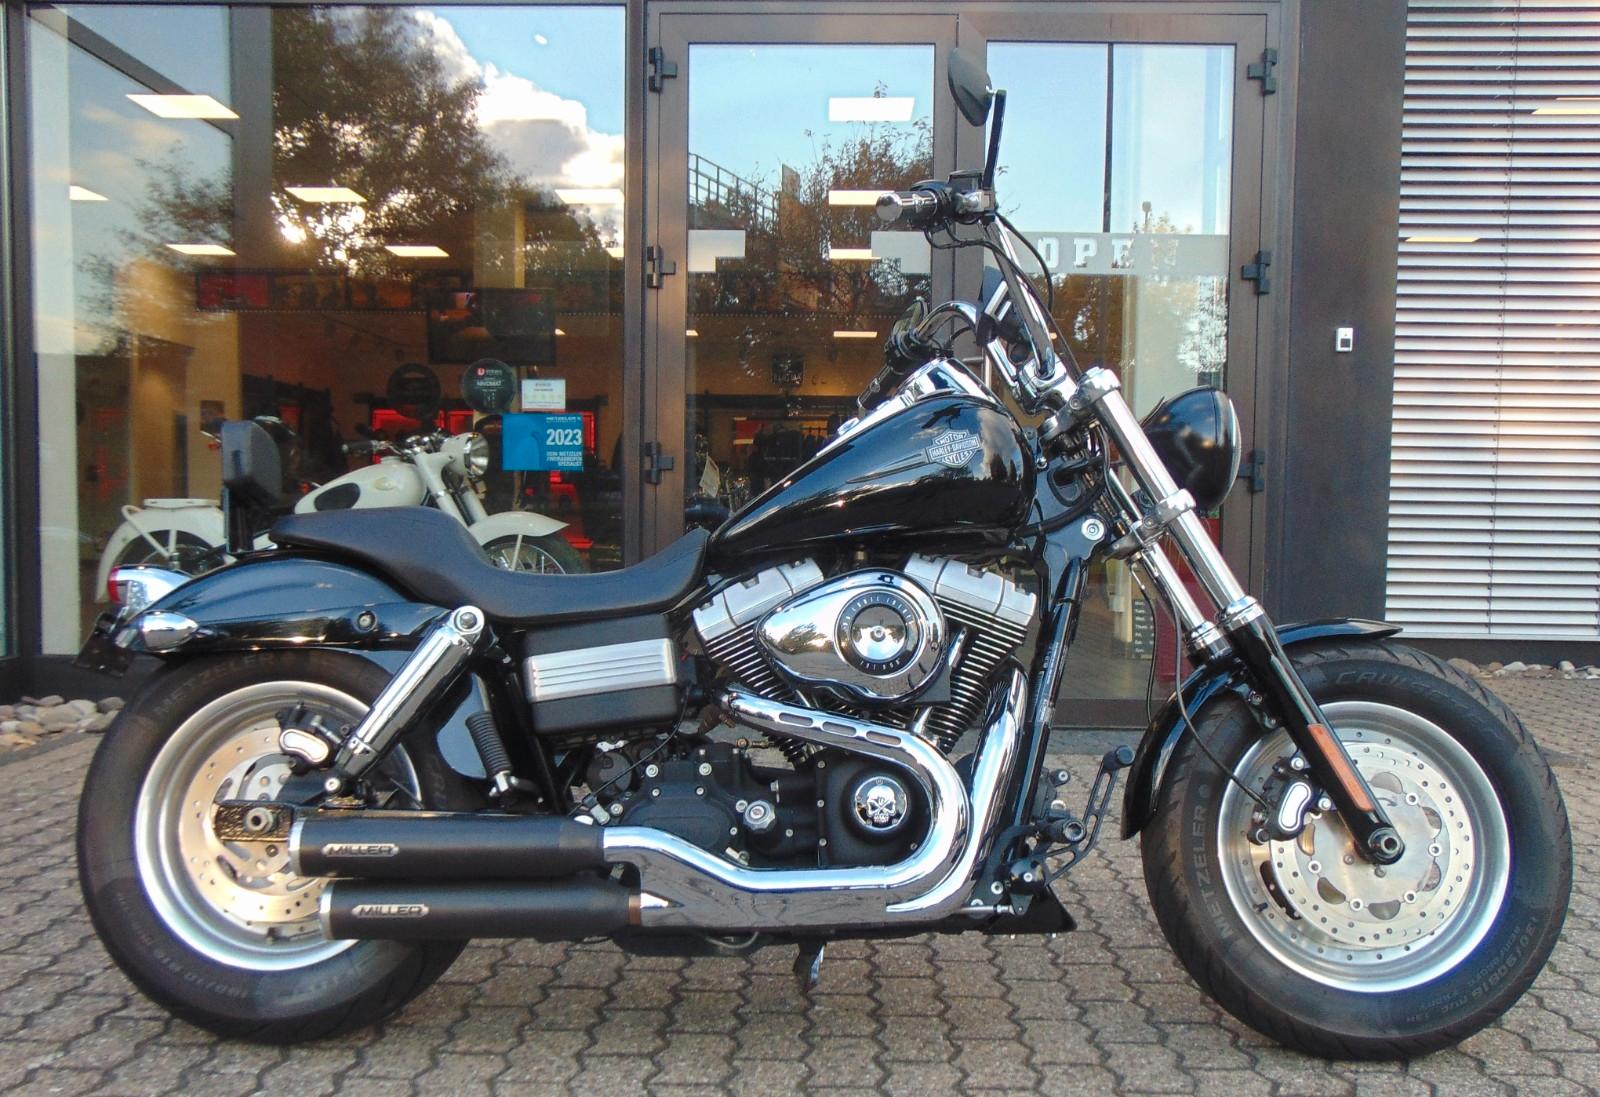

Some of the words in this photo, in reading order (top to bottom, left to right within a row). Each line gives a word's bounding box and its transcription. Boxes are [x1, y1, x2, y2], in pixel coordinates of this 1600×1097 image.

[546, 428, 582, 446] 2023
[939, 433, 965, 445] MOTOR
[931, 438, 977, 458] HARLEY-DAVIDSON
[944, 451, 969, 464] CYCLES
[328, 845, 393, 855] MILLER
[1191, 806, 1235, 940] METZELER
[358, 905, 422, 916] MILLER
